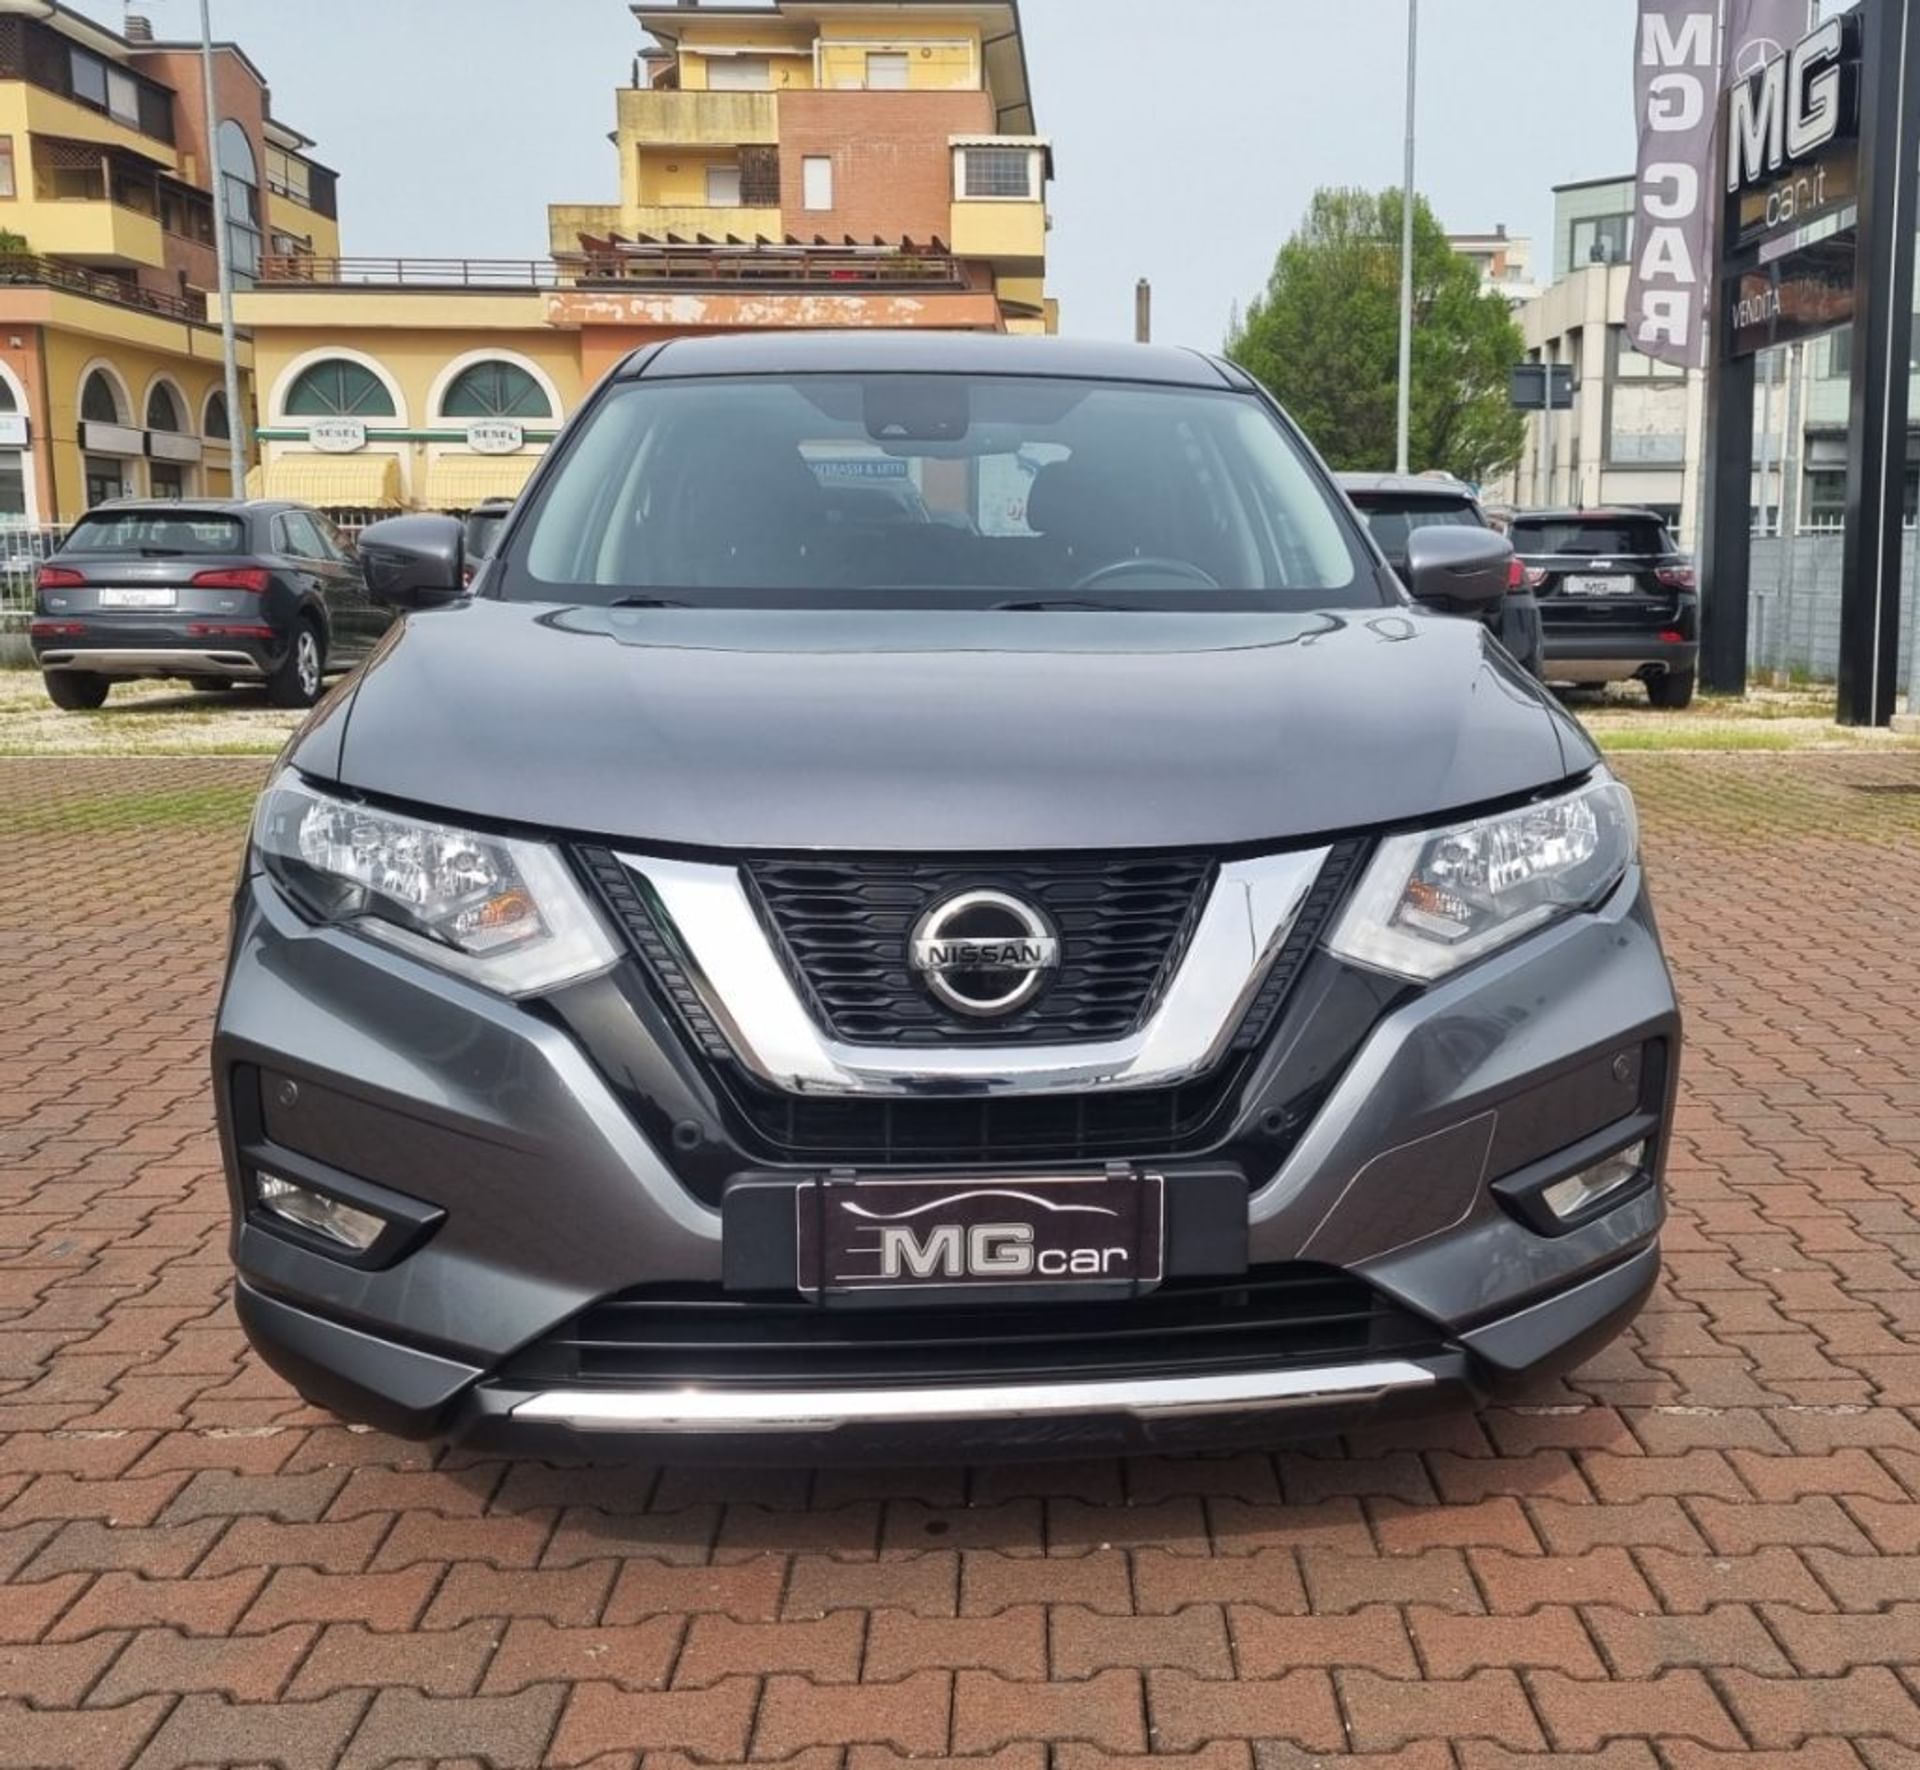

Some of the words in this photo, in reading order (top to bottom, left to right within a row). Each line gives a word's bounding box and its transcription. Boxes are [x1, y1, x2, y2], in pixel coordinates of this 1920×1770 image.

[1727, 15, 1841, 193] MG
[1766, 164, 1827, 228] car.it
[1732, 287, 1781, 330] VENDITA
[928, 944, 1041, 964] NISSAN
